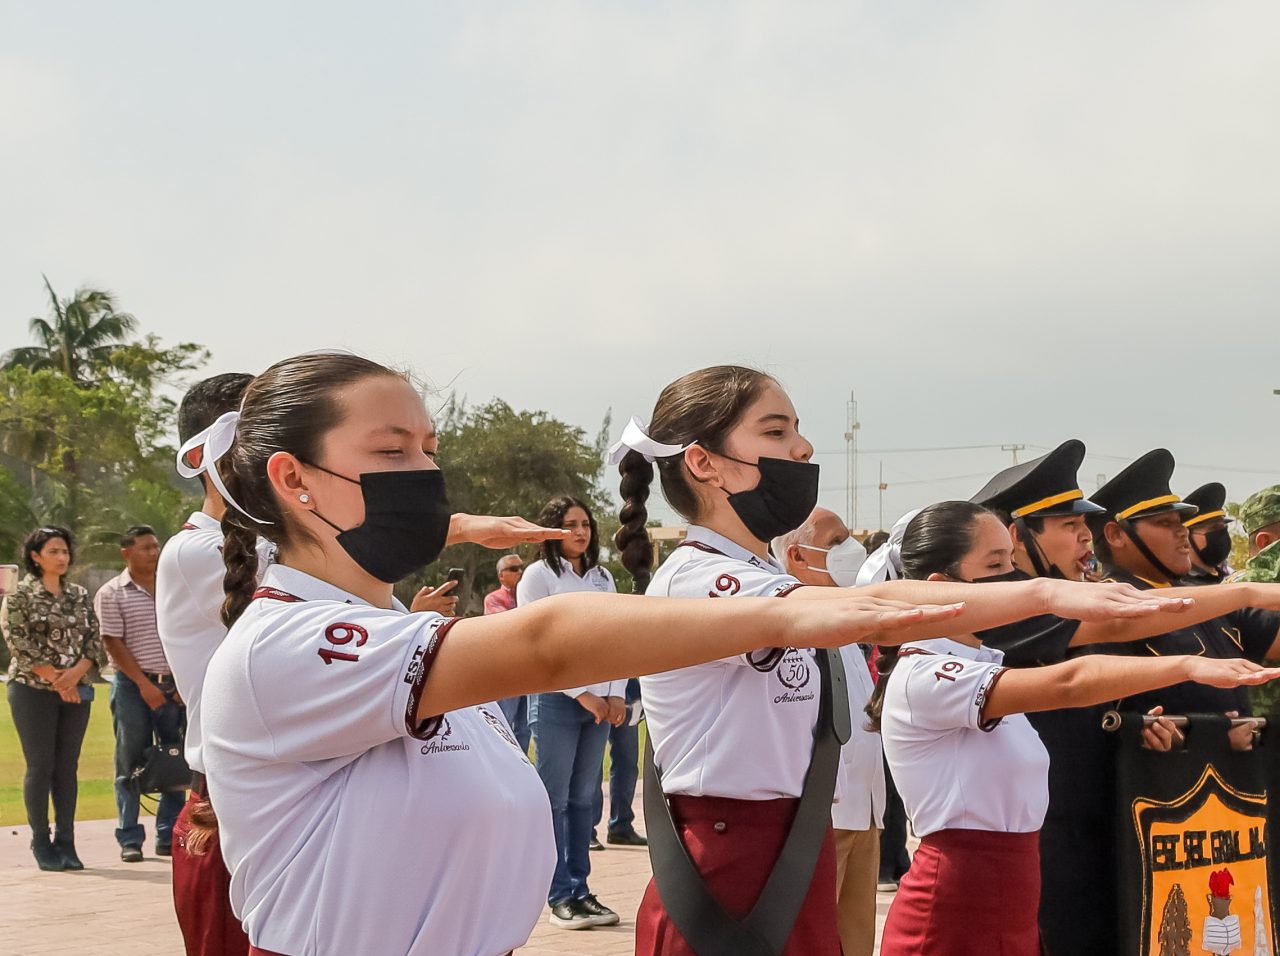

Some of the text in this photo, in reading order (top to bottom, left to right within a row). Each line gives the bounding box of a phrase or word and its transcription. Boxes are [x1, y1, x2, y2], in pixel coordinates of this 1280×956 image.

[317, 622, 368, 665] 19
[403, 645, 427, 685] EST
[786, 664, 804, 681] 50
[934, 661, 964, 682] 19
[975, 684, 986, 706] EST
[421, 741, 470, 755] Aniversario
